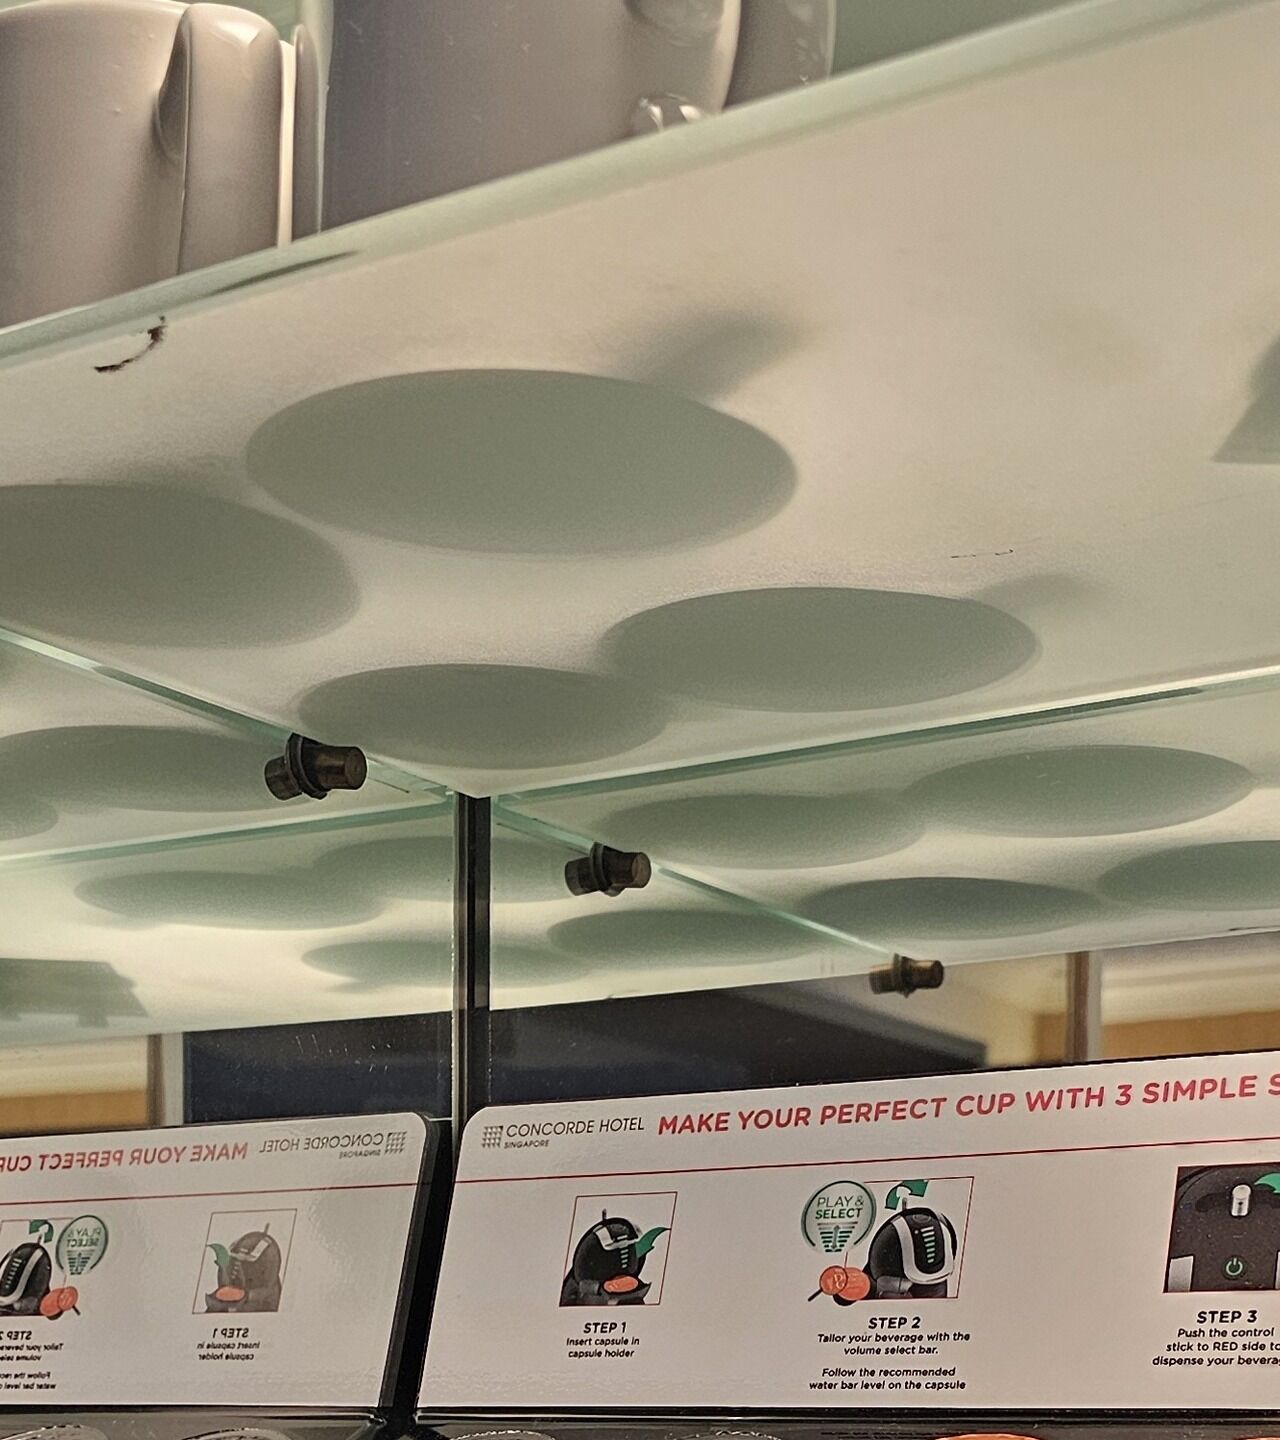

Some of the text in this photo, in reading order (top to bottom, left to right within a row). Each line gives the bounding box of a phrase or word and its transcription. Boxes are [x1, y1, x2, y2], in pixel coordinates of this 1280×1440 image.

[658, 1112, 730, 1135] MAKE
[738, 1106, 810, 1132] YOUR
[819, 1097, 948, 1126] PERFECT
[955, 1093, 1016, 1118] CUP
[1025, 1086, 1105, 1113] WITH
[1116, 1083, 1132, 1107] 3
[1142, 1074, 1258, 1104] SIMPLE
[506, 1116, 645, 1138] CONCORDE HOTEL
[504, 1139, 550, 1149] SINGAPORE
[816, 1194, 865, 1208] PLAY &
[815, 1207, 864, 1220] SELECT
[868, 1316, 921, 1330] STEP 2
[1196, 1309, 1258, 1324] STEP 3
[583, 1320, 627, 1334] STEP 1
[1177, 1327, 1275, 1338] Push the control
[566, 1336, 640, 1347] Insert capsule in
[817, 1331, 971, 1345] Tailor your beverage with the
[844, 1344, 939, 1355] volume select bar.
[1166, 1341, 1194, 1352] stick
[1197, 1342, 1210, 1352] to
[1212, 1341, 1239, 1352] RED
[1241, 1341, 1266, 1351] side
[568, 1348, 635, 1360] capsule holder
[1152, 1355, 1204, 1368] dispense
[1207, 1357, 1234, 1367] your
[822, 1367, 956, 1378] Follow the recommended
[809, 1379, 967, 1392] water bar level on the capsule
